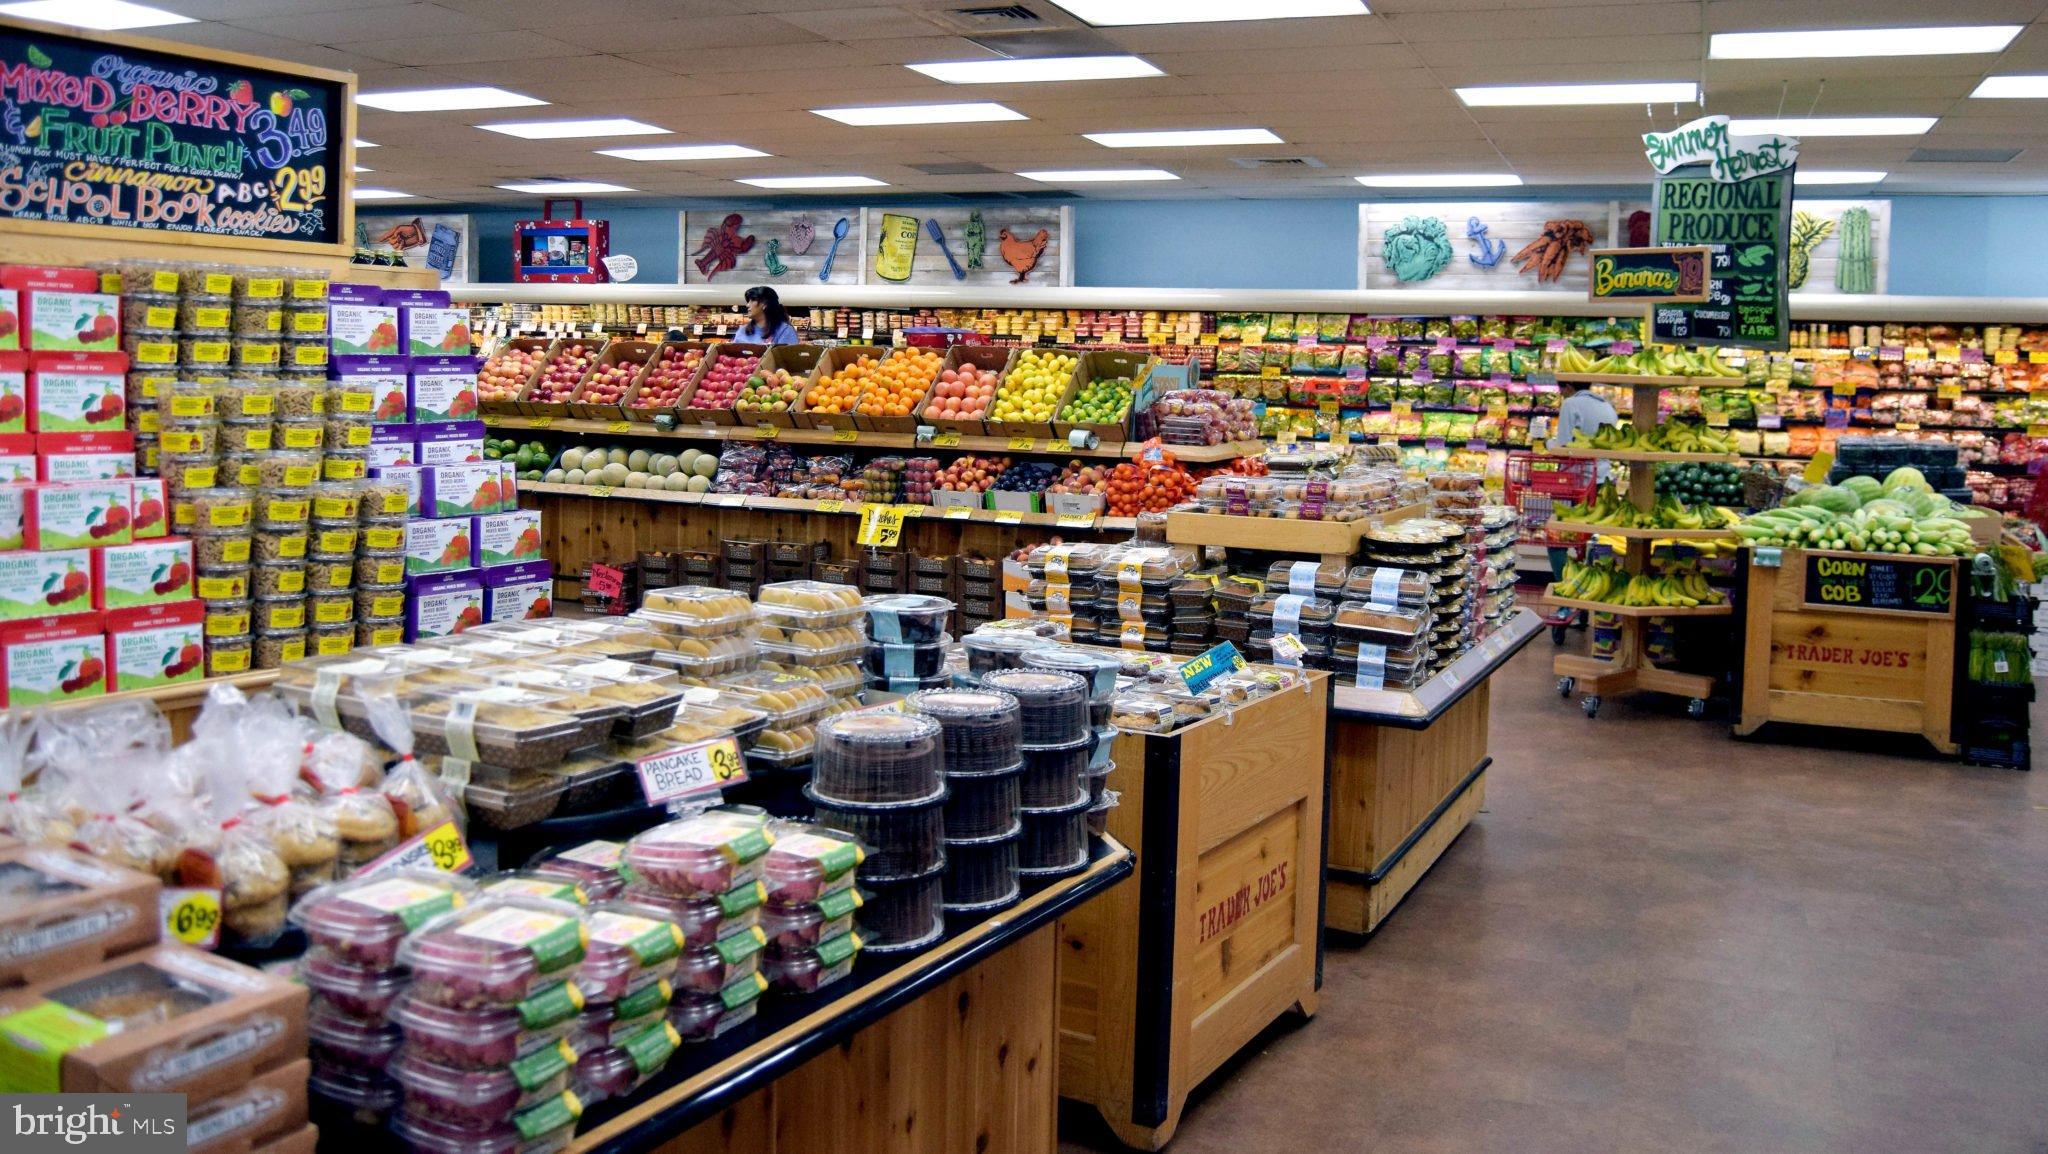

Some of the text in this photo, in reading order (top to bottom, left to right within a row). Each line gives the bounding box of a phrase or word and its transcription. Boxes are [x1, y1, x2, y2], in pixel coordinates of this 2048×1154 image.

[91, 54, 218, 95] Organic
[144, 120, 244, 173] PUNCH
[1644, 121, 1730, 171] Summer
[6, 145, 32, 155] LUNCH
[56, 150, 82, 161] MUST
[164, 163, 181, 174] FOR
[1715, 137, 1789, 181] Harvest
[1662, 180, 1782, 210] REGIONAL
[12, 211, 42, 220] LEARN
[112, 219, 138, 229] WHILE
[166, 223, 193, 232] ENJOY
[1668, 212, 1774, 241] PRODUCE
[1595, 256, 1679, 297] Bananas
[428, 446, 451, 454] ORGANIC
[412, 526, 436, 534] ORGANIC
[486, 520, 508, 528] ORGANIC
[1817, 557, 1867, 577] CORN
[424, 599, 447, 608] ORGANIC
[497, 590, 520, 599] ORGANIC
[1820, 584, 1862, 603] COB
[1179, 654, 1214, 680] NEW
[1786, 644, 1910, 668] TRADER JOE'S
[644, 751, 702, 775] PANCAKE
[654, 766, 703, 791] BREAD
[1199, 861, 1288, 944] TRADER JOE'S
